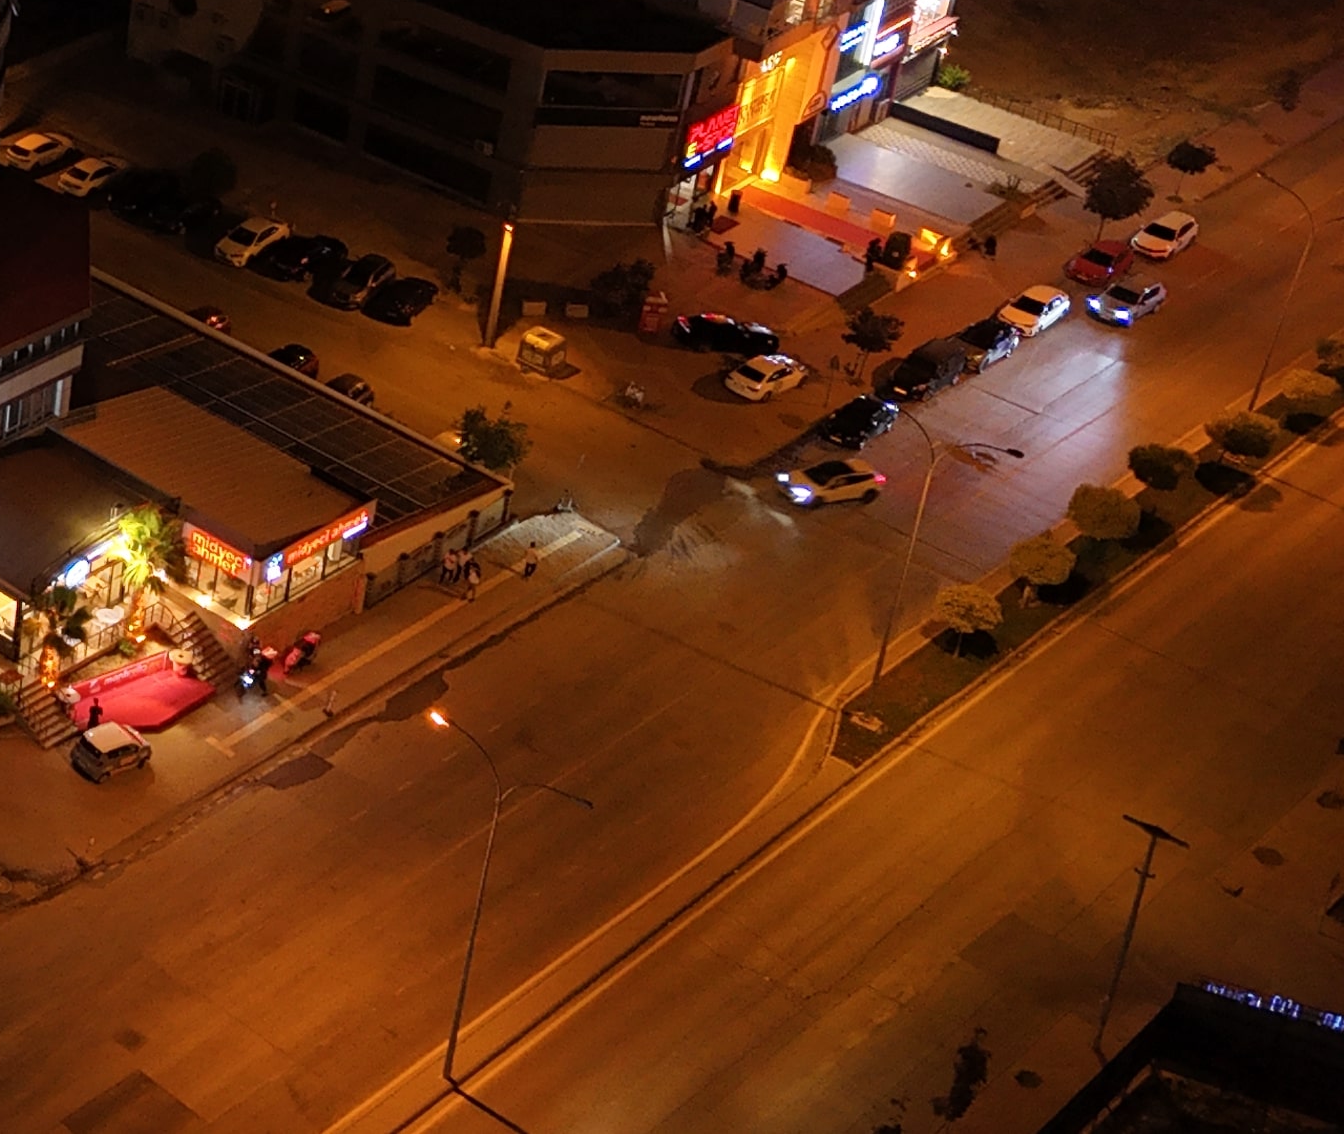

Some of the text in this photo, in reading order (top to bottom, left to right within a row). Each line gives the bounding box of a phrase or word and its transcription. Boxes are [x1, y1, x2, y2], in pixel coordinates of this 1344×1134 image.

[689, 106, 739, 143] PLANET
[192, 531, 249, 570] midyeci
[192, 543, 237, 576] ahmet
